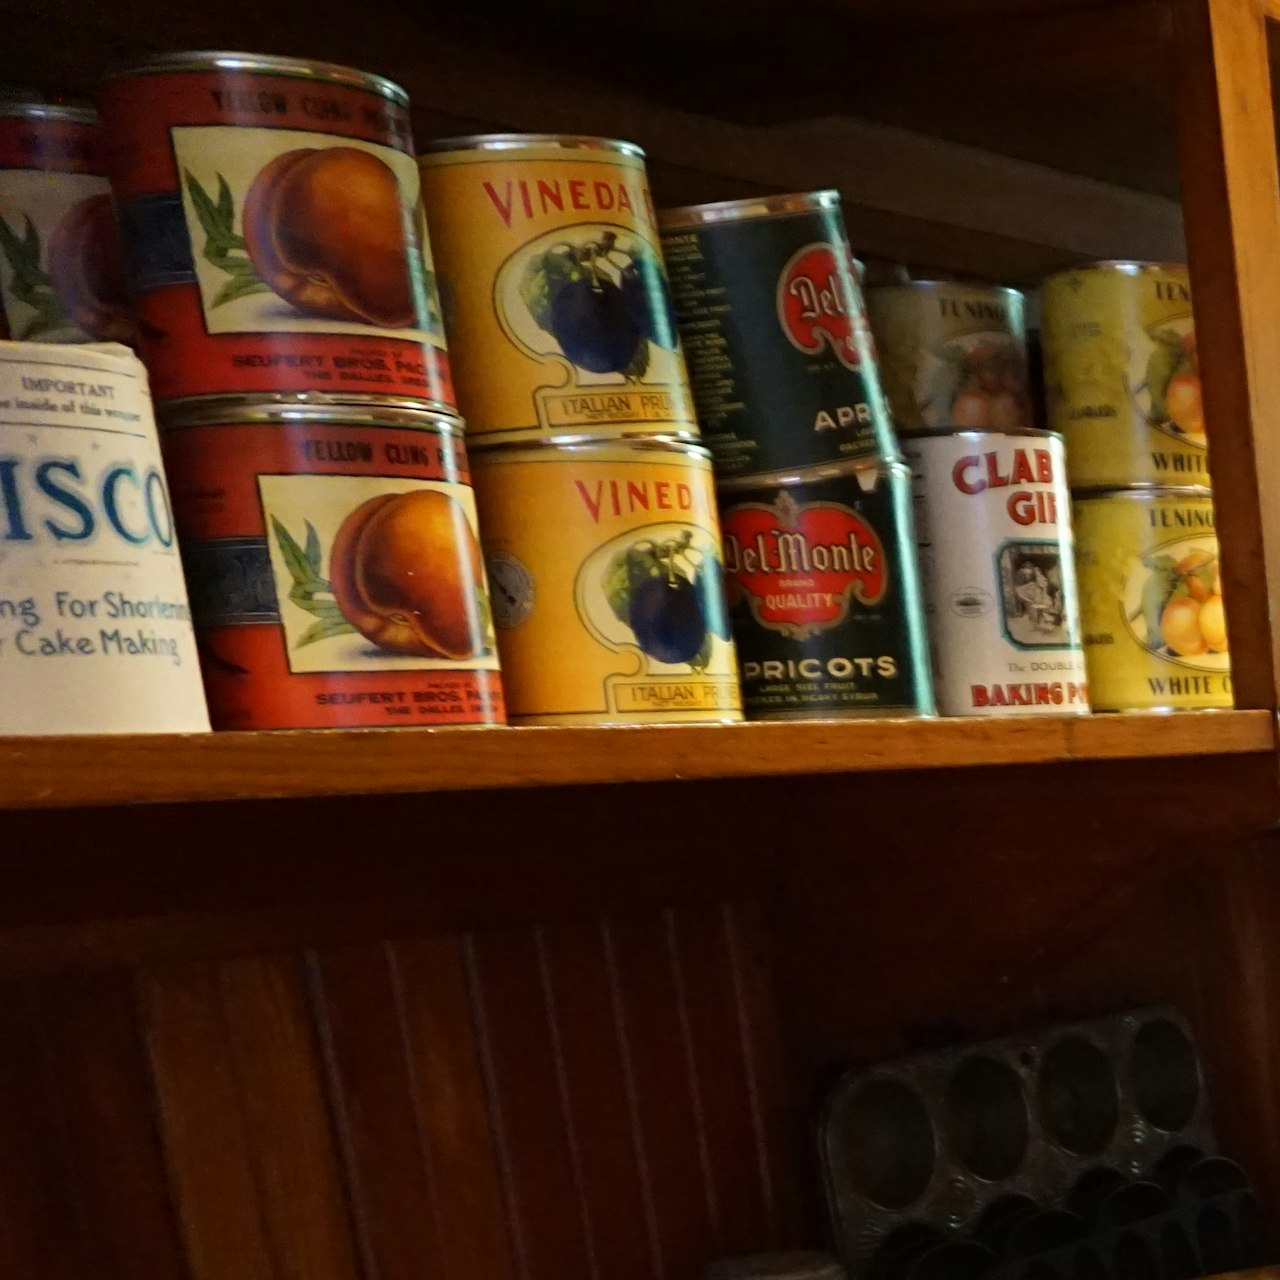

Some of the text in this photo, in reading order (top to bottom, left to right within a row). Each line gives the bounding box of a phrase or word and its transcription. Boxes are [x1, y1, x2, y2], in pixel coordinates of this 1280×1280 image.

[21, 375, 115, 399] IMPORTANT
[16, 398, 58, 413] inside
[62, 401, 75, 413] of
[561, 394, 632, 416] ITALIAN
[303, 439, 429, 465] YELLOW CLING
[772, 529, 875, 573] Monte
[55, 590, 97, 619] For
[765, 592, 834, 609] QUALITY
[15, 628, 182, 666] Cake Making
[1007, 661, 1026, 673] The
[631, 686, 694, 702] ITALIAN
[824, 682, 855, 691] FRUIT
[971, 682, 1064, 707] BAKING
[1148, 676, 1213, 696] WHITE
[315, 691, 406, 705] SEUFERT
[841, 692, 879, 701] SYRUP
